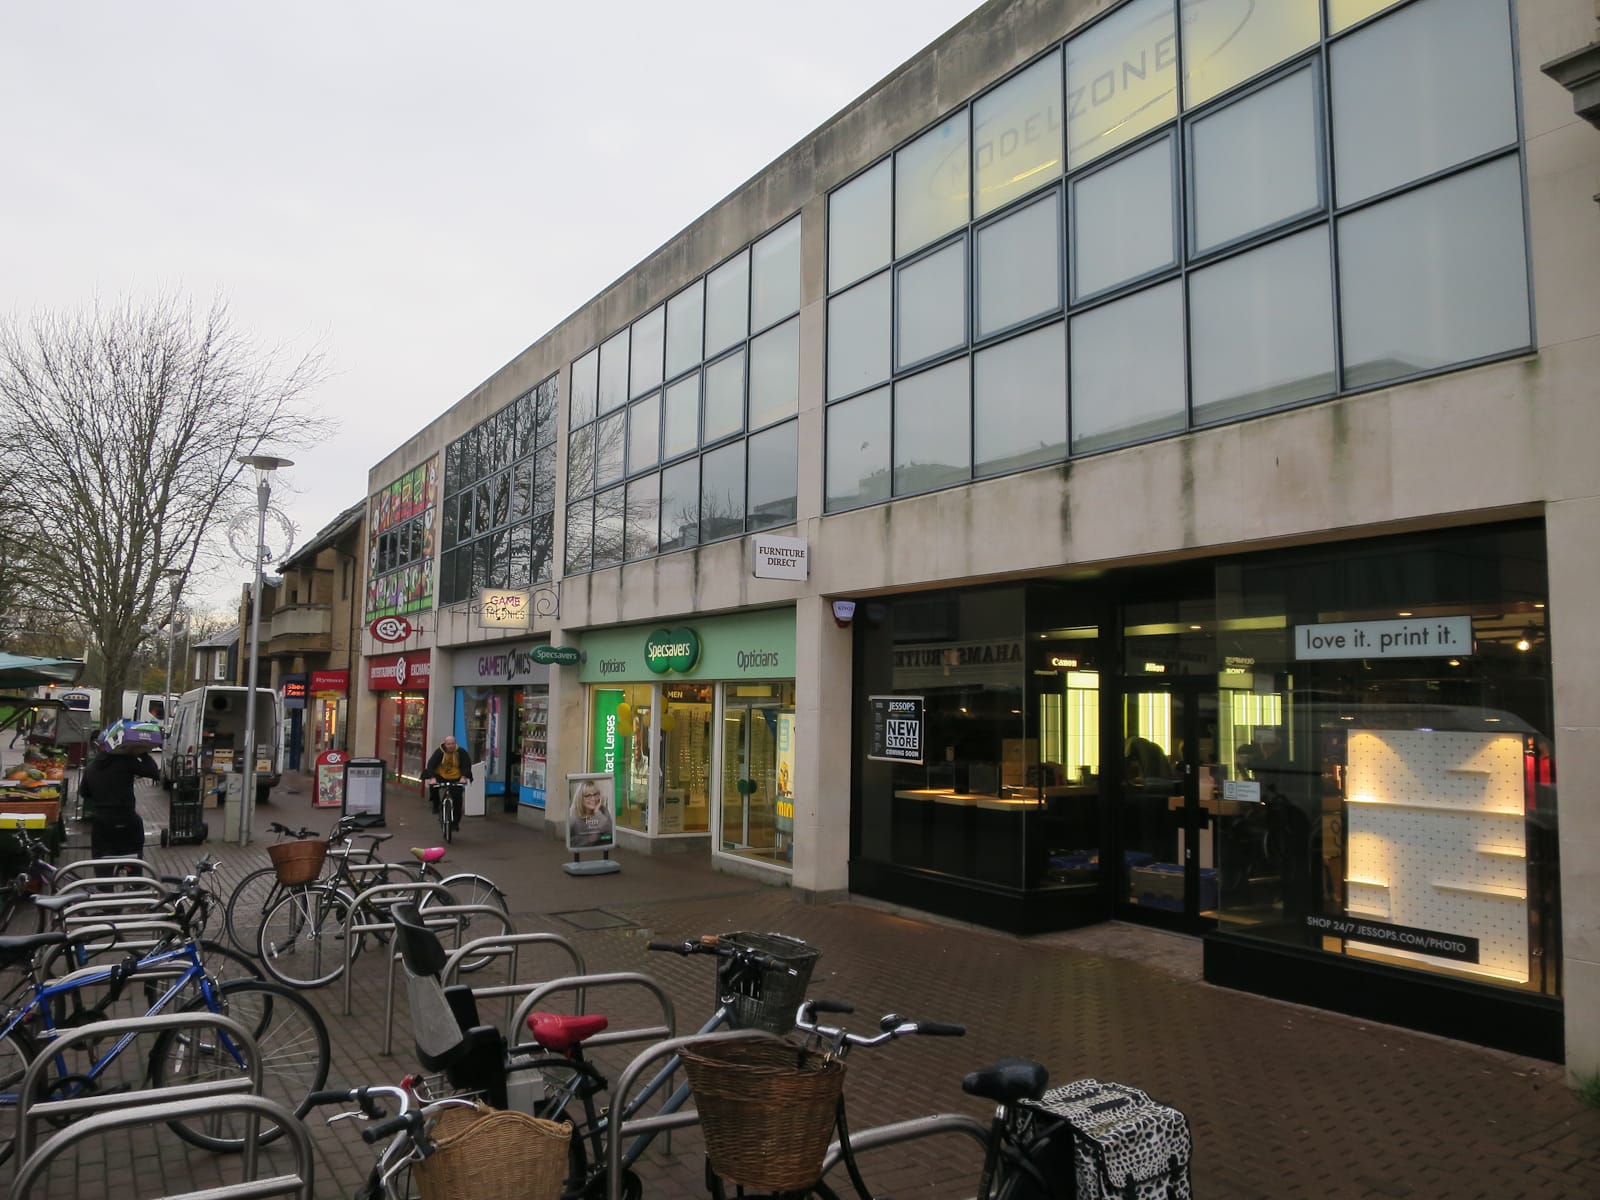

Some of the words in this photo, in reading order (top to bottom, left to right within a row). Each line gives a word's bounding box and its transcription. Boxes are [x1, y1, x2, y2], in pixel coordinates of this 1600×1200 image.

[759, 546, 805, 558] FURNITURE
[767, 558, 797, 567] DIRECT
[490, 596, 521, 607] GAME
[1307, 629, 1346, 649] love
[1354, 629, 1371, 648] it.
[1380, 626, 1429, 653] print
[1437, 624, 1457, 645] it.
[537, 650, 577, 661] Specsavers
[648, 642, 690, 661] Specsavers
[478, 648, 531, 680] GAMETRONICS
[599, 657, 626, 676] Opticians
[737, 649, 779, 671] Opticians
[1051, 657, 1078, 668] Canon
[667, 690, 683, 699] MEN
[887, 702, 915, 712] JESSOPS
[604, 714, 616, 750] Lenses
[887, 721, 918, 737] NEW
[887, 736, 918, 748] STORE
[1306, 916, 1332, 929] SHOP
[1333, 921, 1355, 934] 24/7
[1357, 925, 1467, 954] JESSOPS.COM/PHOTO
